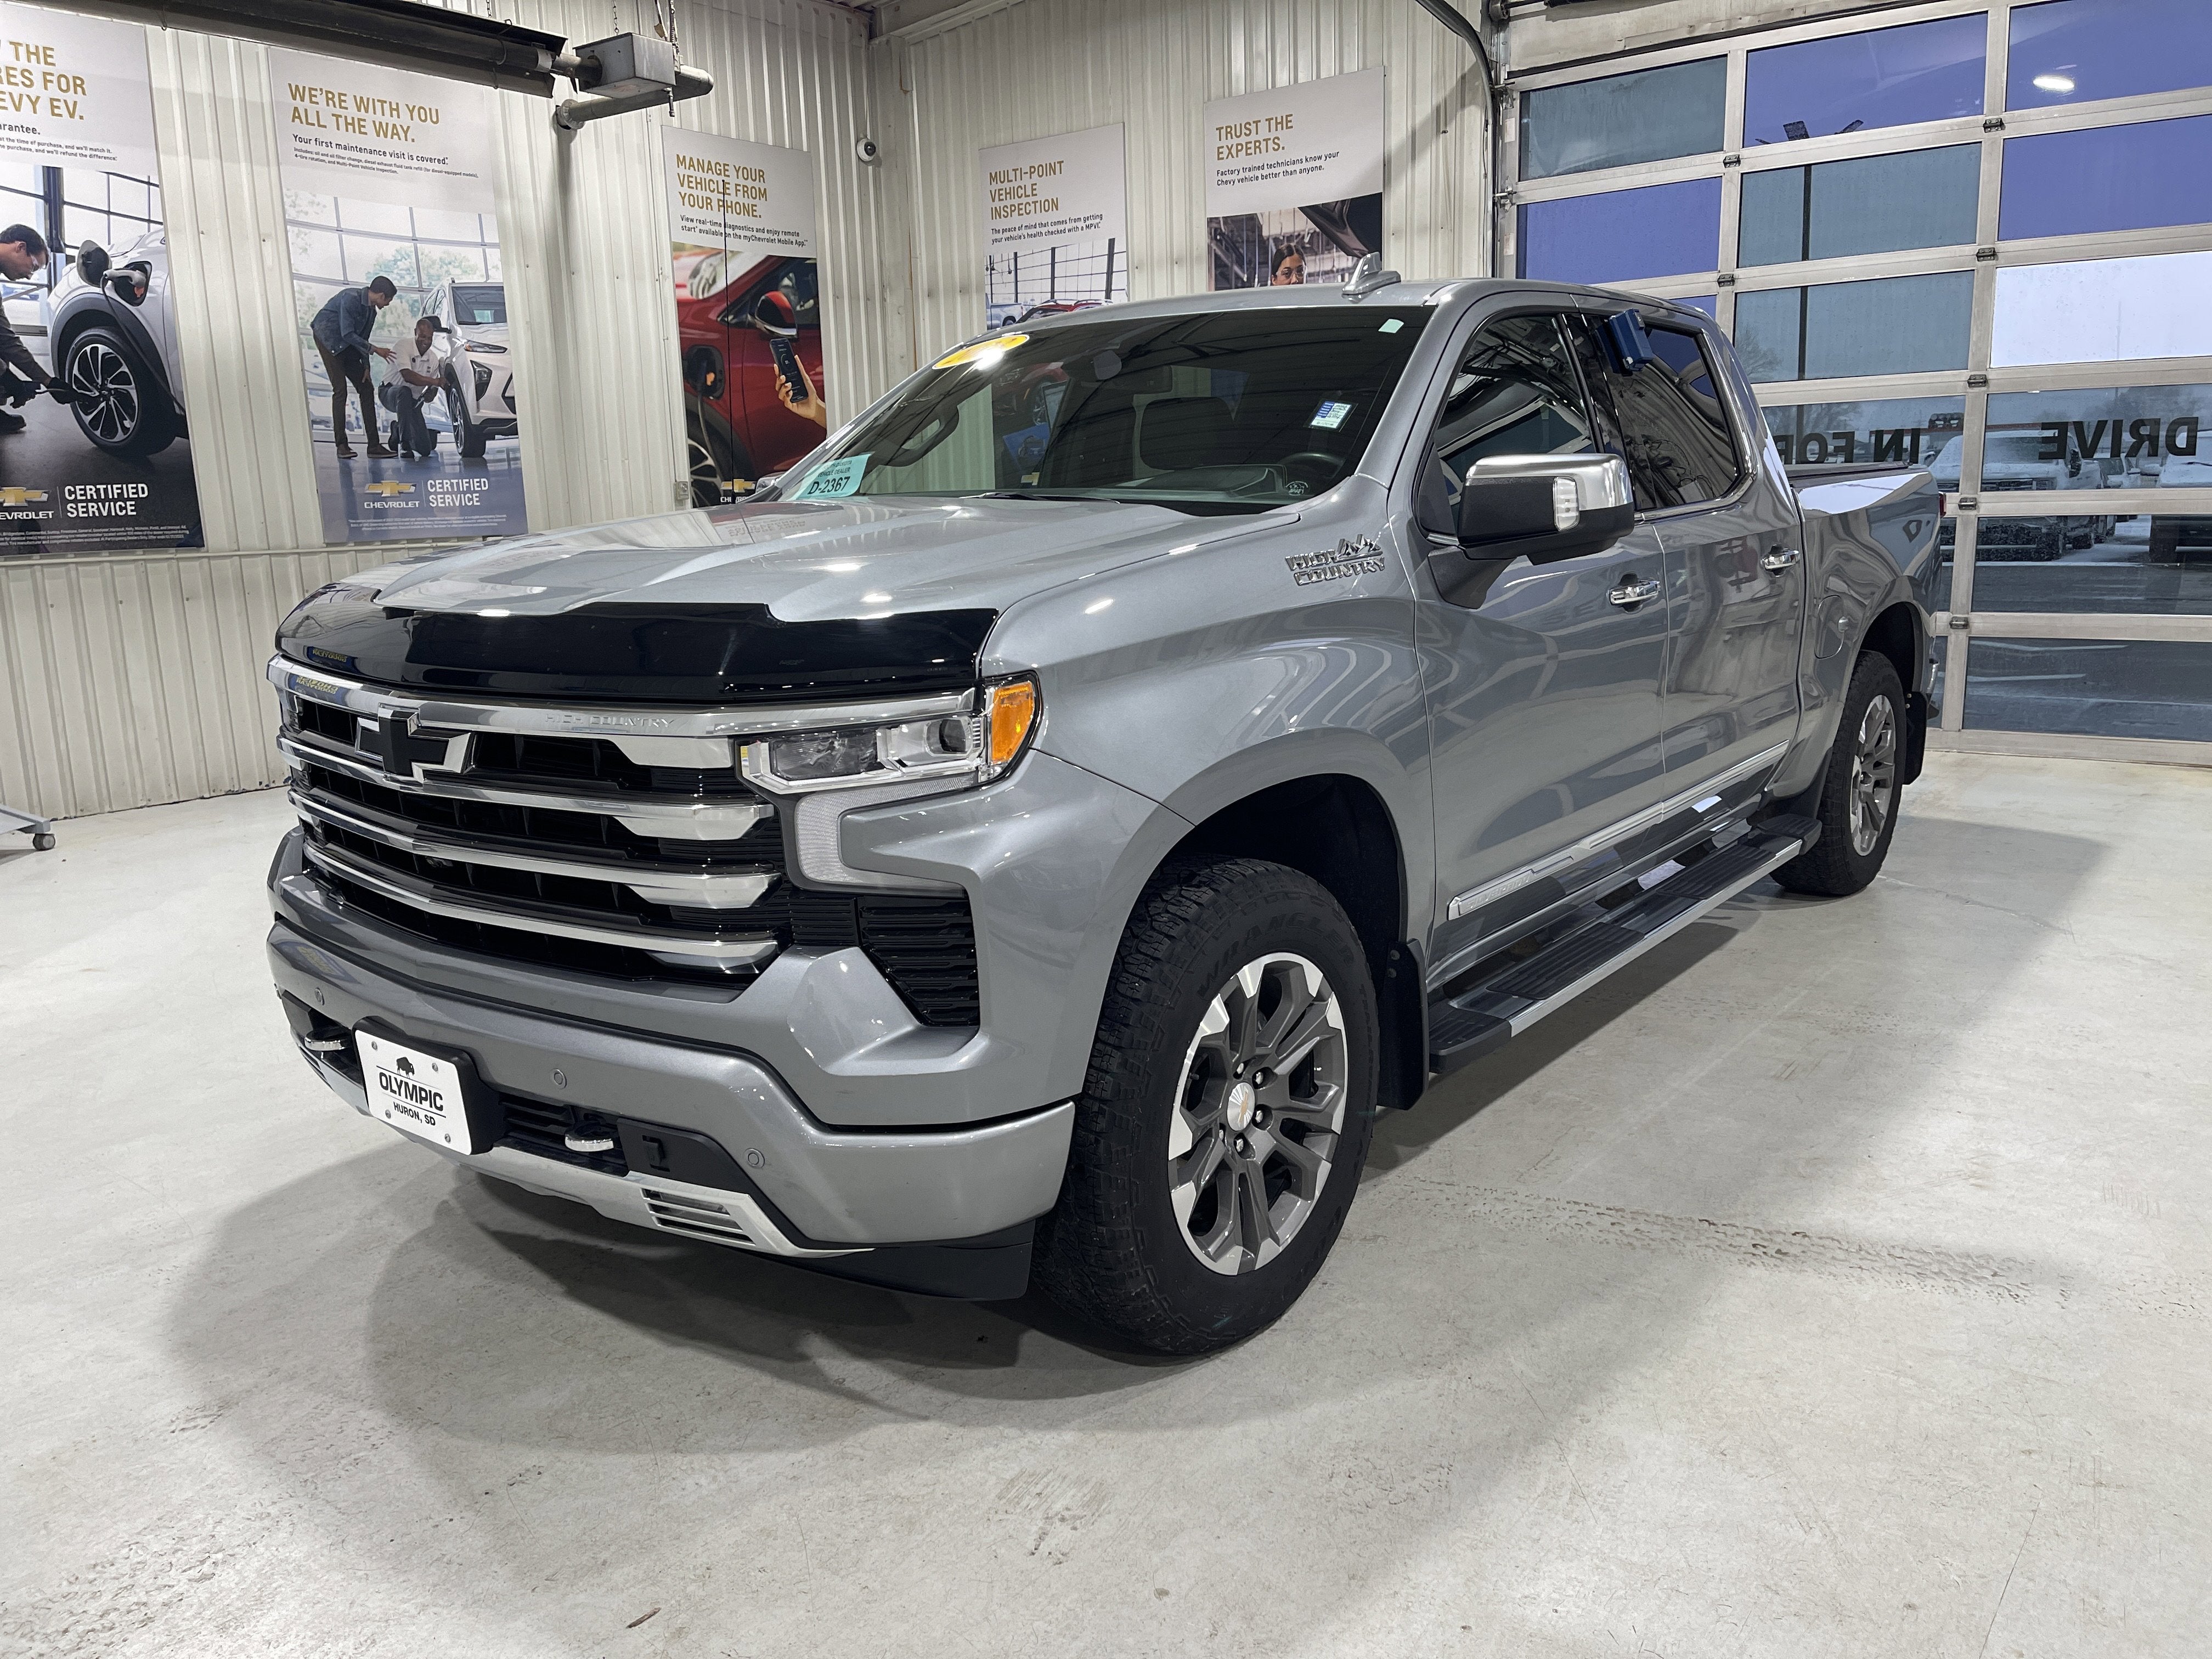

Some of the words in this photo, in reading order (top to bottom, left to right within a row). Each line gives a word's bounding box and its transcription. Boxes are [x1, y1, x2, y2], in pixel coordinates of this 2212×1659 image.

[9, 41, 56, 66] THE
[43, 71, 87, 95] FOR
[49, 98, 84, 120] EV.
[287, 83, 348, 110] WE'RE
[353, 95, 400, 119] WITH
[405, 103, 439, 125] YOU
[291, 106, 327, 129] ALL
[331, 113, 368, 135] THE
[373, 120, 415, 143] WAY.
[1216, 120, 1261, 142] TRUST
[1265, 114, 1294, 133] THE
[292, 134, 312, 145] Your
[314, 138, 333, 148] first
[335, 143, 387, 157] maintenance
[388, 150, 405, 160] visit
[407, 152, 414, 161] is
[1217, 136, 1285, 161] EXPERTS.
[676, 154, 730, 178] MANAGE
[733, 165, 765, 184] YOUR
[989, 160, 1064, 185] MULTI-POINT
[1217, 168, 1240, 177] Factory
[1242, 163, 1265, 173] trained
[1266, 158, 1303, 170] technicians
[1305, 155, 1323, 163] know
[1324, 151, 1339, 161] your
[1237, 174, 1259, 183] vehicle
[1261, 172, 1281, 180] better
[1299, 165, 1324, 174] anyone.
[677, 173, 731, 196] VEHICLE
[735, 183, 768, 201] FROM
[990, 183, 1037, 203] VEHICLE
[679, 191, 713, 211] YOUR
[717, 199, 762, 218] PHONE.
[991, 198, 1059, 220] INSPECTION
[680, 215, 694, 223] View
[696, 218, 722, 228] real-time
[766, 228, 780, 236] enjoy
[1002, 227, 1017, 235] peace
[1024, 222, 1037, 230] mind
[1083, 213, 1103, 223] getting
[699, 228, 723, 237] available
[743, 235, 776, 244] myChevrolet
[777, 238, 793, 246] Mobile
[991, 237, 1003, 245] your
[1004, 233, 1026, 242] vehicle's
[1026, 231, 1043, 239] health
[1044, 227, 1066, 236] checked
[64, 483, 149, 501] CERTIFIED
[427, 478, 489, 493] CERTIFIED
[807, 476, 851, 495] D-2367
[66, 501, 137, 518] SERVICE
[364, 501, 420, 509] CHEVROLET
[429, 493, 481, 507] SERVICE
[1285, 549, 1337, 571] HIGH
[1293, 557, 1385, 586] COUNTRY
[590, 715, 675, 728] COUNTRY
[379, 1072, 444, 1112] OLYMPIC
[393, 1101, 422, 1124] HURON,
[424, 1114, 436, 1126] SD
